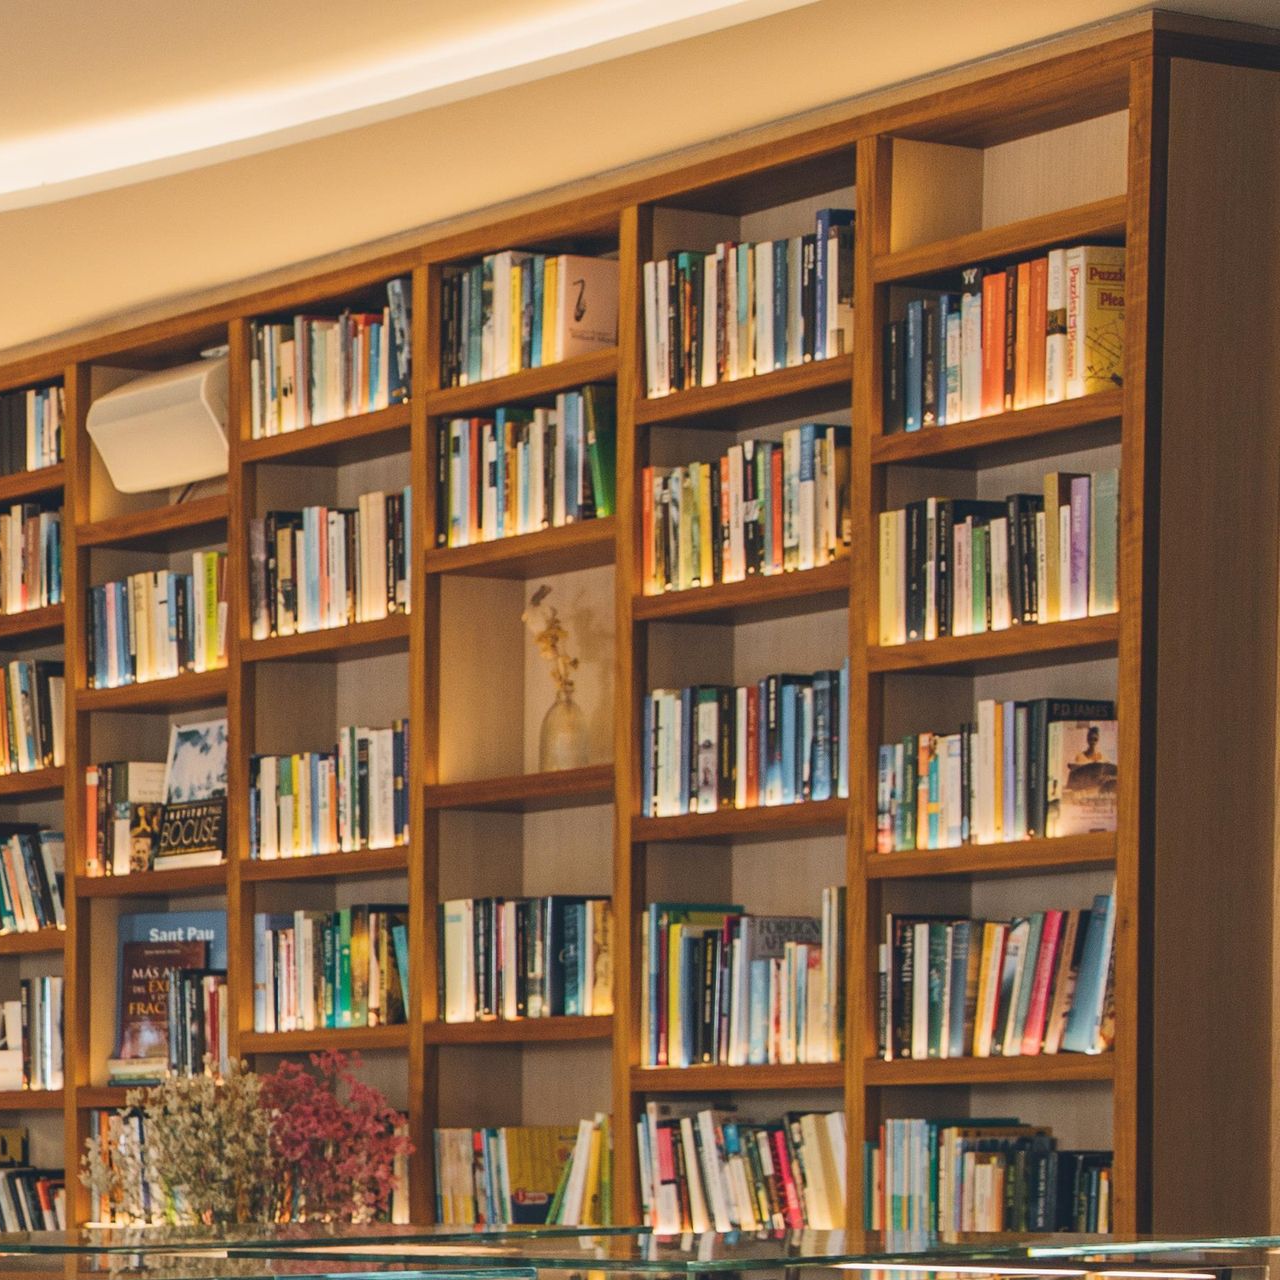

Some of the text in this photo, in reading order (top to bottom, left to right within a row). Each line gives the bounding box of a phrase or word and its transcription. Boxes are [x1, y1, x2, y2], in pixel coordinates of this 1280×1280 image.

[160, 815, 220, 847] BOCUSE
[149, 926, 215, 942] Sant Pau
